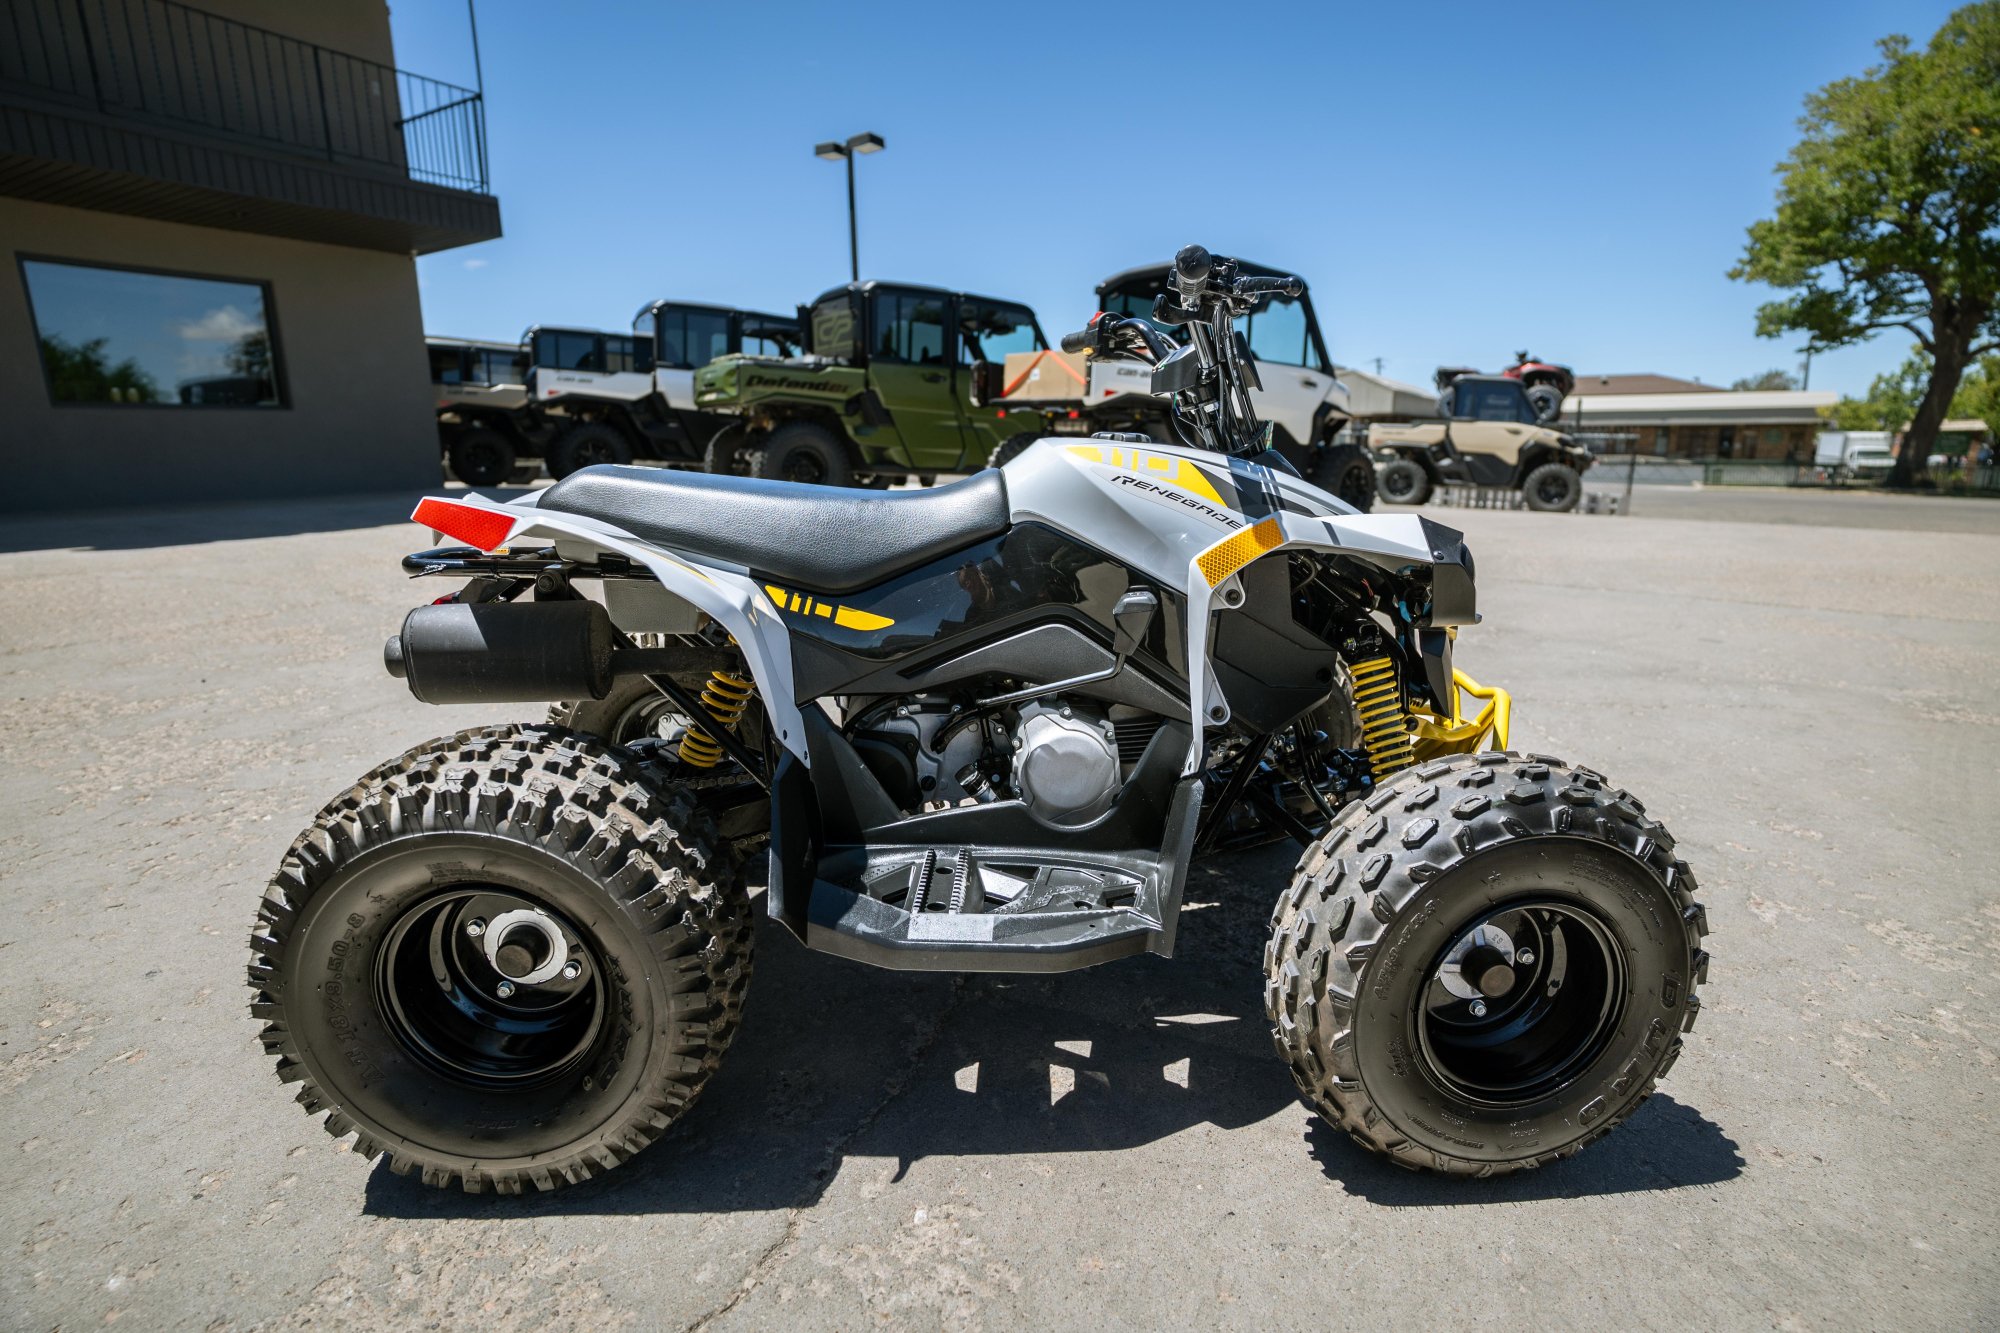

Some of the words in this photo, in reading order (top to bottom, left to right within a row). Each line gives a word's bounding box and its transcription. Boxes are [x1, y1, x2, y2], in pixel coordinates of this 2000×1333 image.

[744, 374, 850, 394] Defender
[1110, 475, 1245, 531] RENEGADE
[1577, 970, 1683, 1127] DURO
